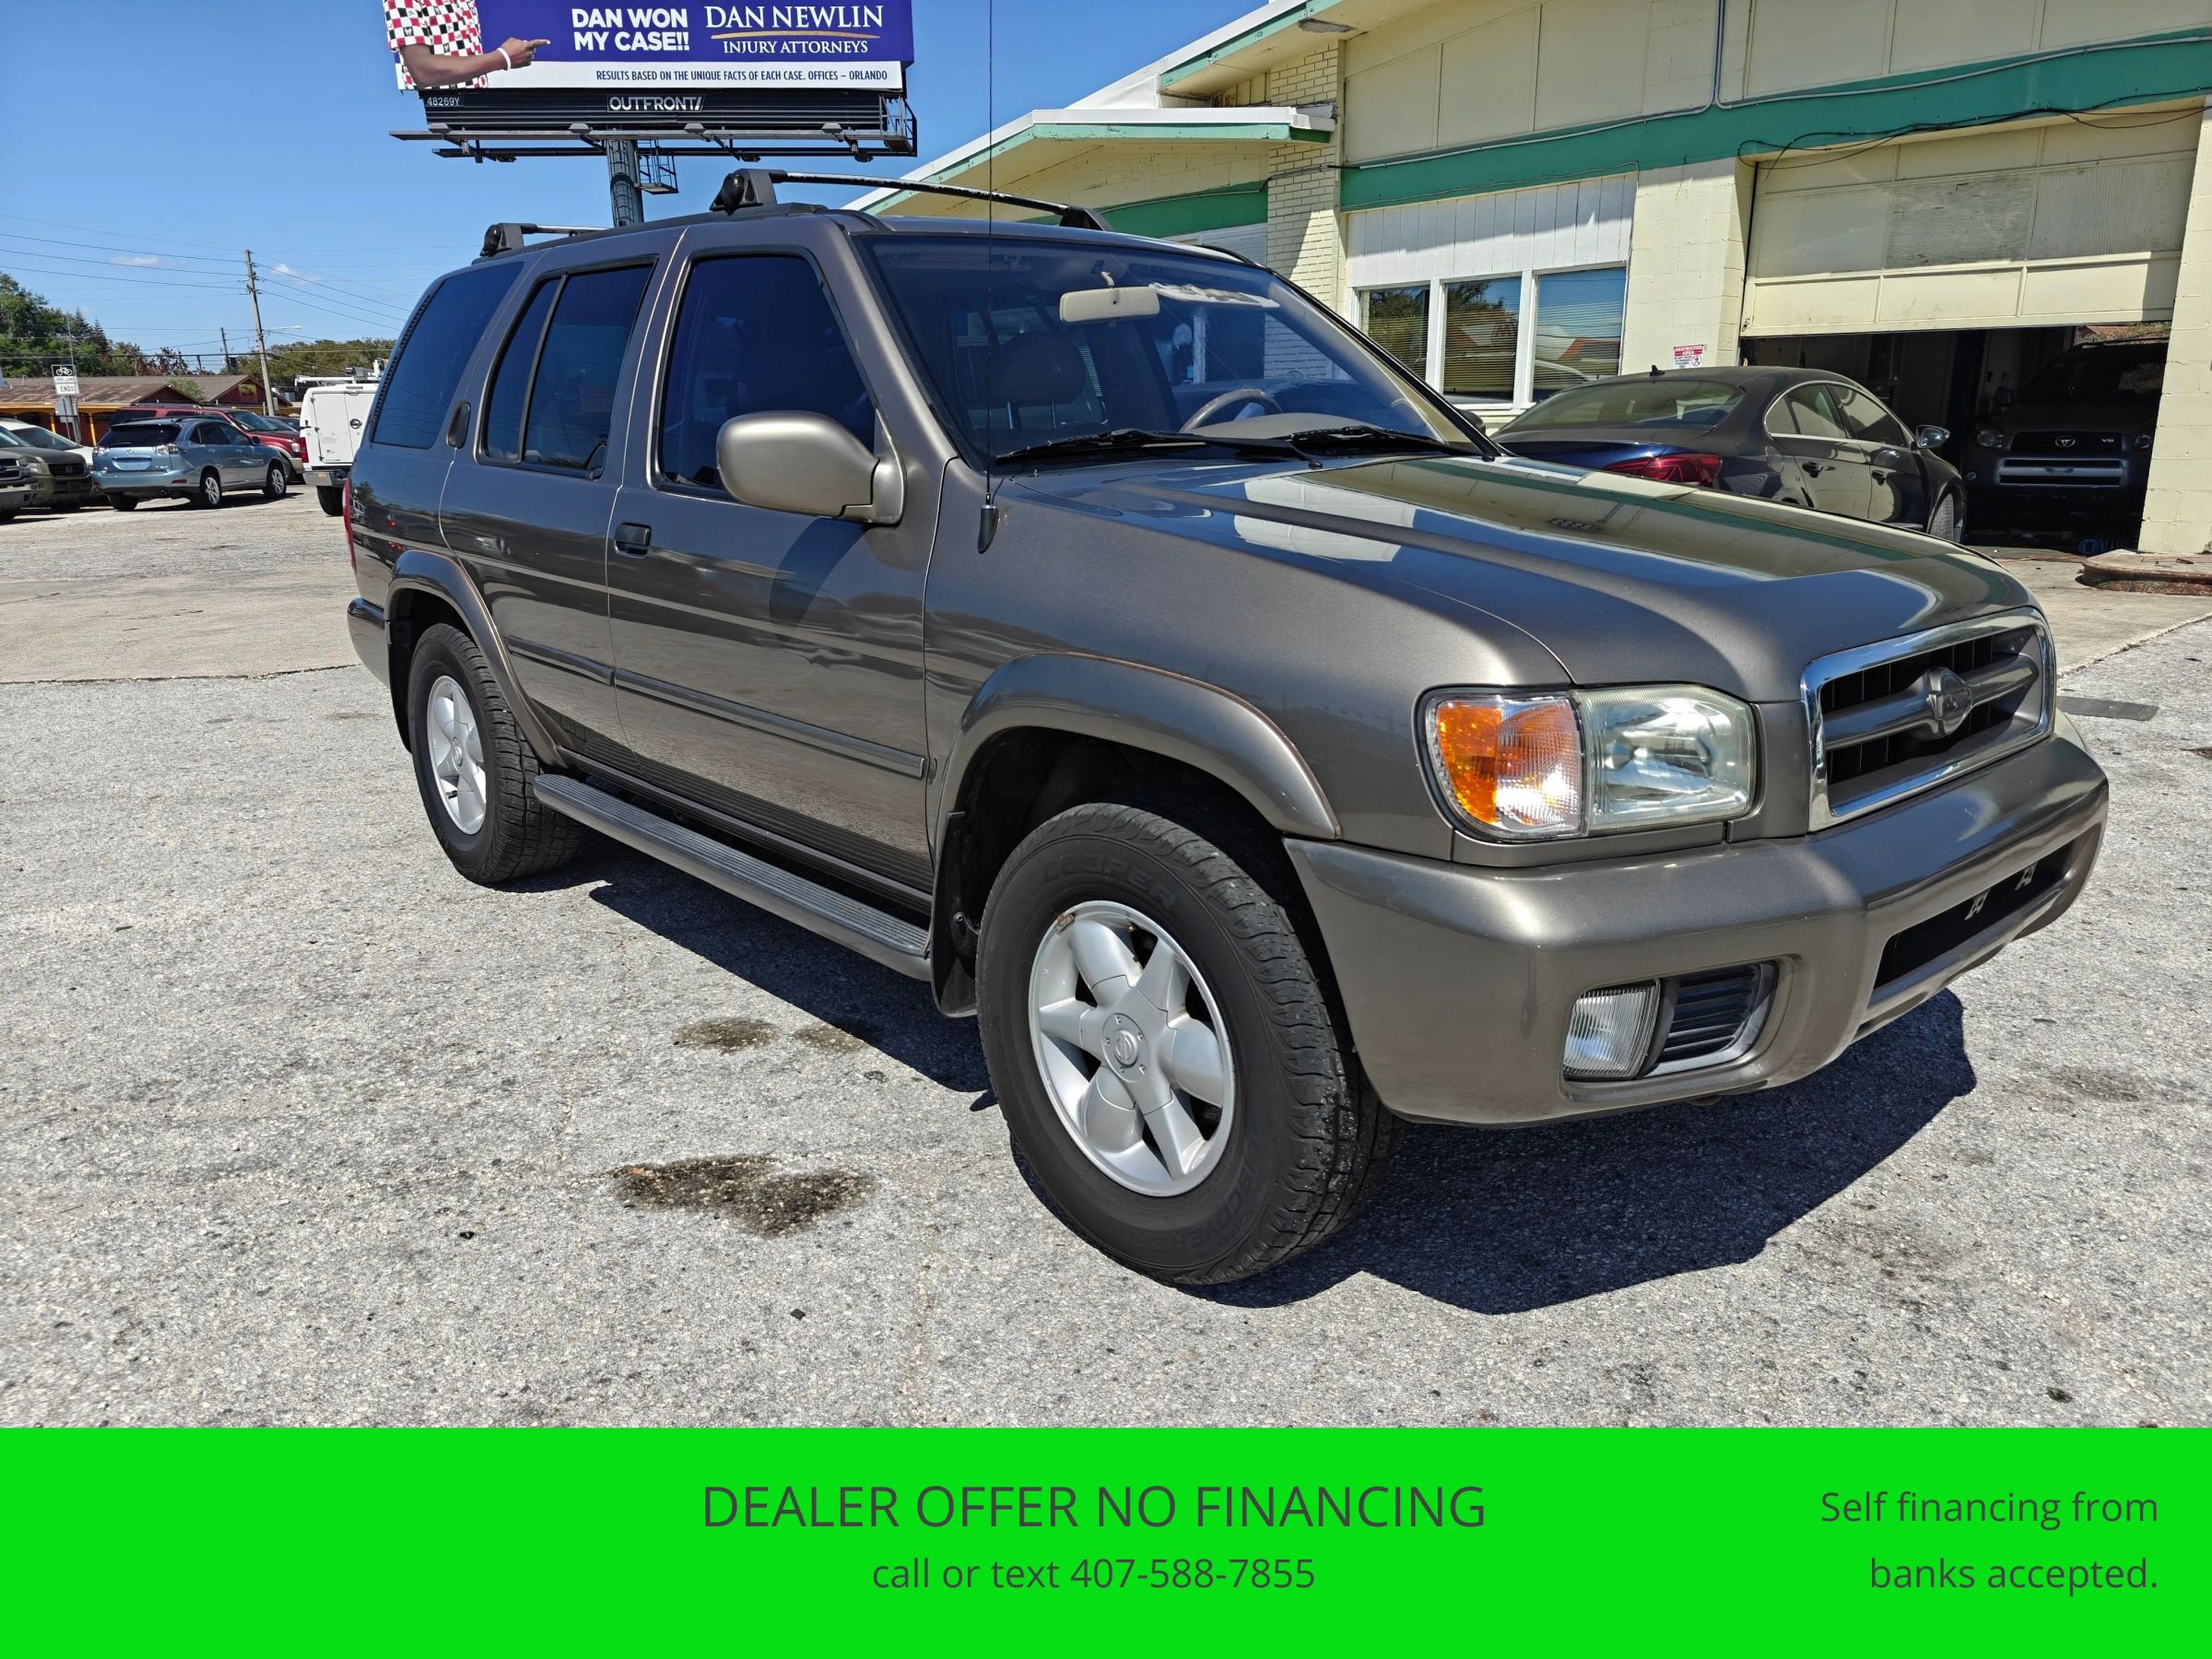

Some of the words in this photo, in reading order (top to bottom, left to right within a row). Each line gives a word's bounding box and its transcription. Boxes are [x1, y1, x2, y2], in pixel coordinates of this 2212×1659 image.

[571, 8, 624, 29] DAN
[627, 8, 688, 29] WON
[703, 6, 764, 29] DAN
[771, 5, 884, 29] NEWLIN
[573, 31, 610, 52] MY
[614, 31, 690, 52] CASE!!
[723, 41, 779, 54] INJURY
[779, 41, 868, 54] ATTORNEYS
[595, 70, 629, 81] RESULTS
[631, 70, 658, 81] BASED
[660, 70, 672, 80] ON
[674, 70, 689, 80] THE
[690, 70, 722, 81] UNIQUE
[724, 70, 747, 80] FACTS
[748, 70, 759, 80] OF
[760, 70, 782, 80] EACH
[783, 70, 806, 81] CASE.
[807, 70, 839, 80] OFFICES
[849, 70, 888, 80] ORLANDO
[427, 97, 460, 106] 48269Y
